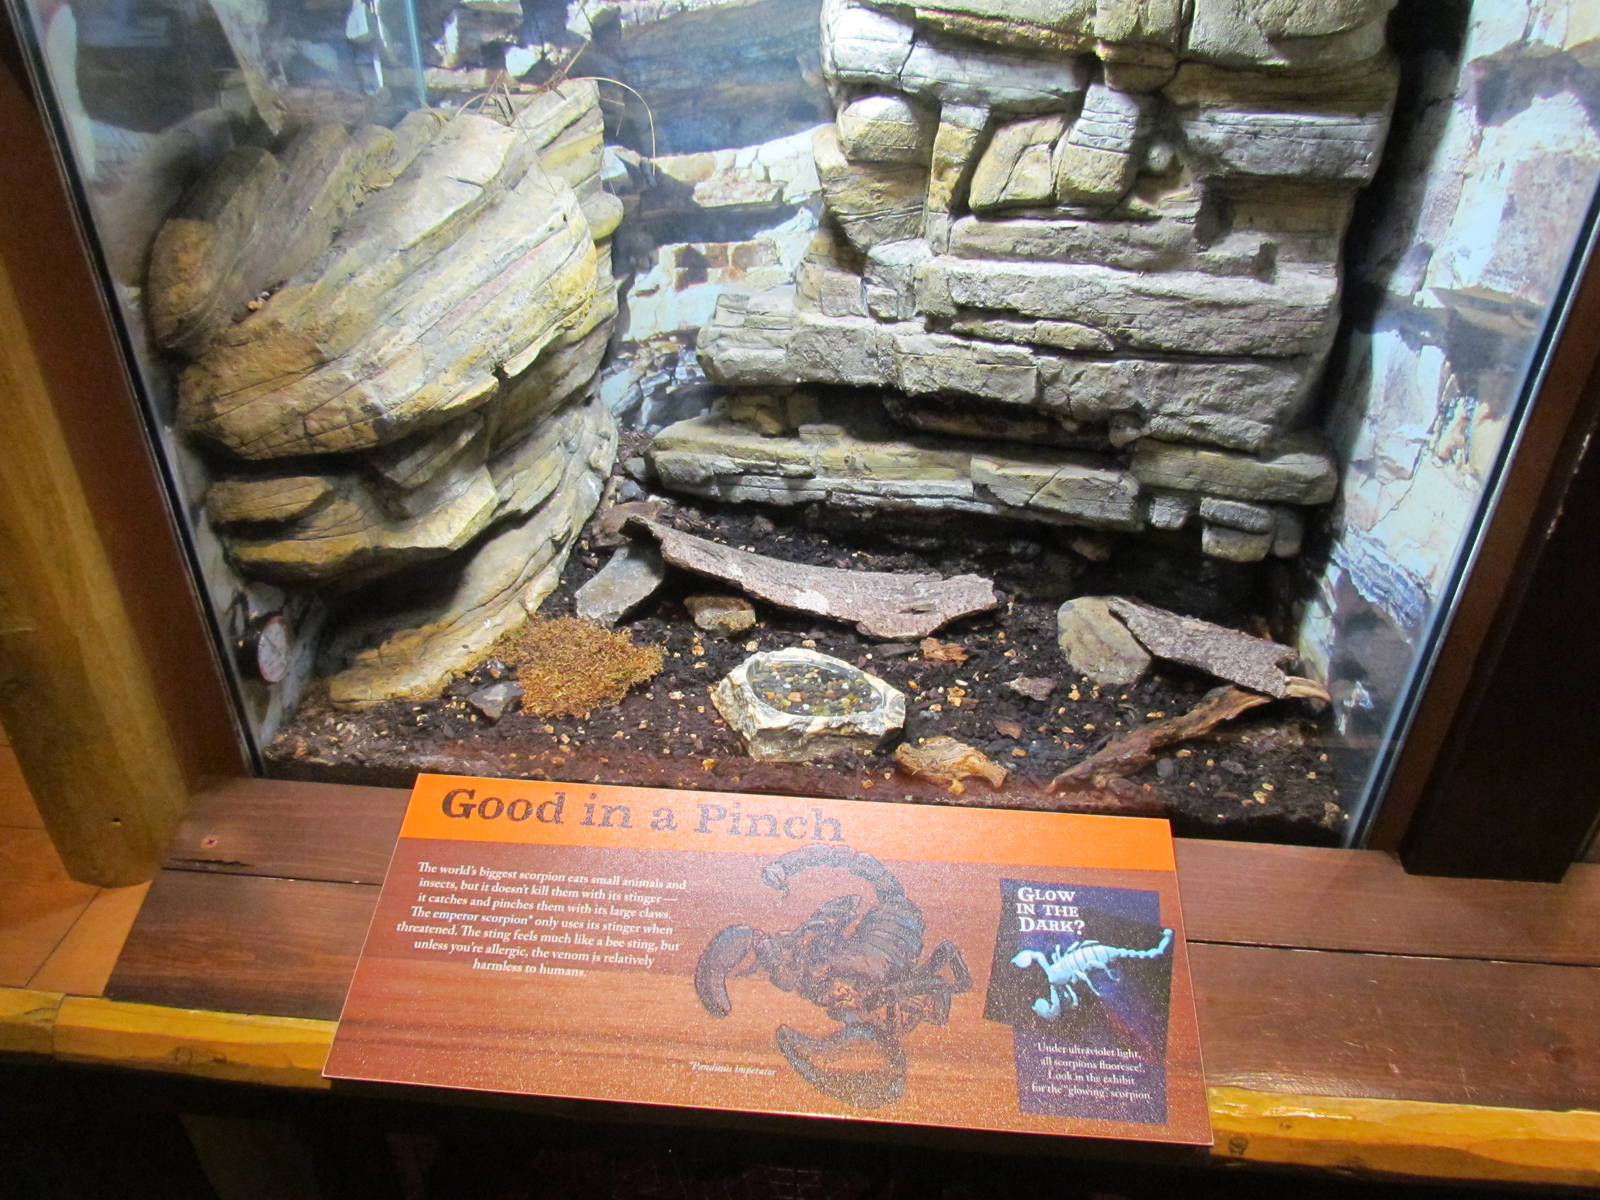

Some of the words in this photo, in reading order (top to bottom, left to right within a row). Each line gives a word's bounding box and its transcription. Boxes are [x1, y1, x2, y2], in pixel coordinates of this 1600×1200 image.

[441, 788, 565, 825] Good
[580, 793, 633, 829] in
[650, 806, 678, 831] a
[694, 803, 844, 842] Pinch
[418, 861, 437, 873] The
[480, 867, 517, 880] biggest
[519, 872, 566, 884] scorpion
[568, 874, 589, 883] eats
[592, 876, 620, 886] small
[622, 878, 664, 889] animals
[666, 880, 687, 890] and
[419, 878, 458, 891] insects,
[461, 880, 479, 891] but
[481, 882, 490, 891] it
[531, 885, 549, 896] kill
[551, 886, 579, 898] them
[582, 888, 606, 900] with
[608, 891, 621, 901] its
[418, 893, 427, 902] it
[429, 895, 468, 905] catches
[470, 897, 491, 907] and
[492, 899, 534, 911] pinches
[536, 901, 565, 912] them
[567, 903, 592, 914] with
[594, 906, 608, 915] its
[609, 905, 637, 920] large
[639, 908, 672, 920] claws.
[1016, 902, 1036, 915] IN
[1042, 904, 1079, 917] THE
[411, 906, 432, 918] The
[433, 910, 480, 923] emperor
[534, 916, 559, 930] only
[561, 919, 584, 929] uses
[587, 920, 600, 930] its
[602, 921, 641, 935] stinger
[643, 923, 674, 935] when
[396, 920, 458, 936] threatened.
[461, 924, 481, 937] The
[483, 929, 512, 943] sting
[513, 930, 538, 942] feels
[540, 932, 571, 944] much
[573, 934, 593, 946] like
[605, 935, 625, 948] bee
[627, 938, 659, 953] sting,
[661, 940, 680, 951] but
[414, 939, 448, 951] unless
[485, 943, 529, 959] allergic,
[531, 946, 550, 958] the
[552, 949, 589, 961] venom
[591, 951, 601, 962] is
[603, 952, 655, 969] relatively
[472, 958, 522, 973] harmless
[525, 963, 537, 973] to
[539, 963, 587, 977] humans.
[1037, 1042, 1067, 1054] Under
[1068, 1045, 1115, 1057] ultraviolet
[1041, 1056, 1052, 1065] all
[1054, 1059, 1098, 1070] scorpions
[1047, 1069, 1072, 1079] Look
[1074, 1071, 1084, 1081] in
[1086, 1072, 1101, 1083] the
[1103, 1073, 1137, 1085] exhibit
[1032, 1082, 1046, 1092] for
[1047, 1084, 1062, 1094] the
[1110, 1089, 1153, 1101] scorpion.
